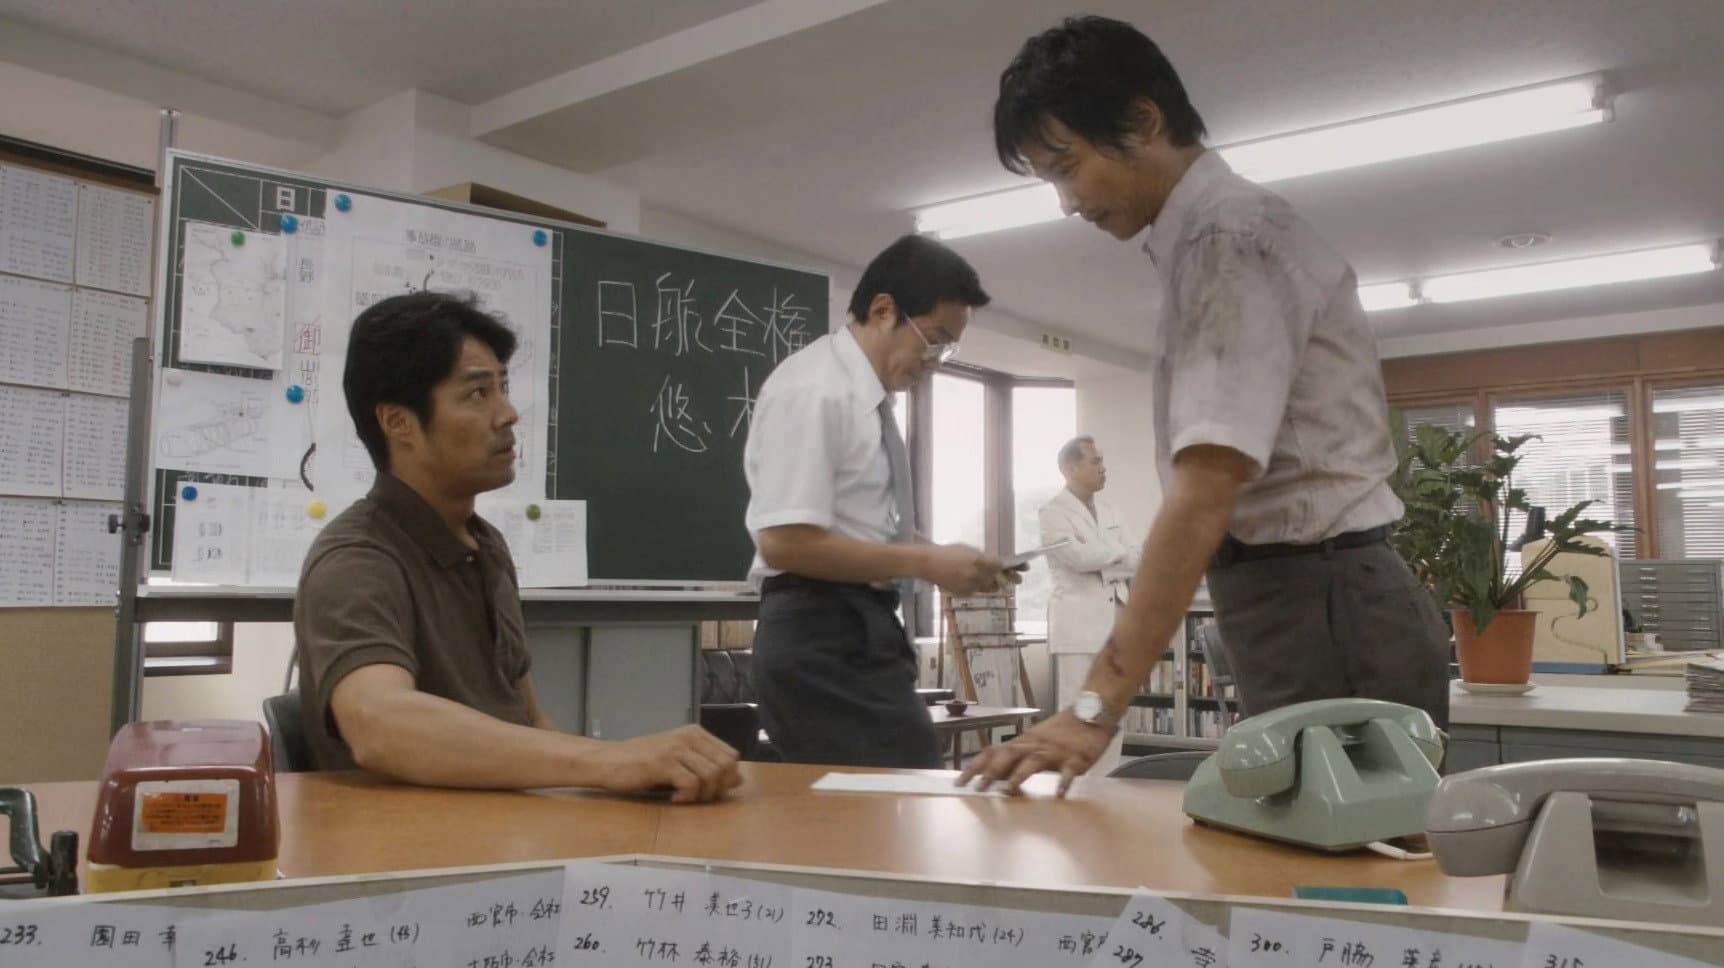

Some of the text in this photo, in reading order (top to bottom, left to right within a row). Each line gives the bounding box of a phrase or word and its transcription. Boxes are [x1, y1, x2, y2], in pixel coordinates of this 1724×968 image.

[597, 271, 813, 364] 日航全権
[644, 888, 685, 912] 竹井
[806, 908, 840, 929] 272.
[873, 914, 917, 936] 田淵
[1132, 912, 1166, 940] 286.
[0, 924, 42, 945] 233.
[90, 925, 141, 949] 園田
[574, 933, 605, 952] 260.
[636, 938, 680, 962] 竹林
[1251, 933, 1288, 954] 300.
[203, 944, 247, 967] 246.
